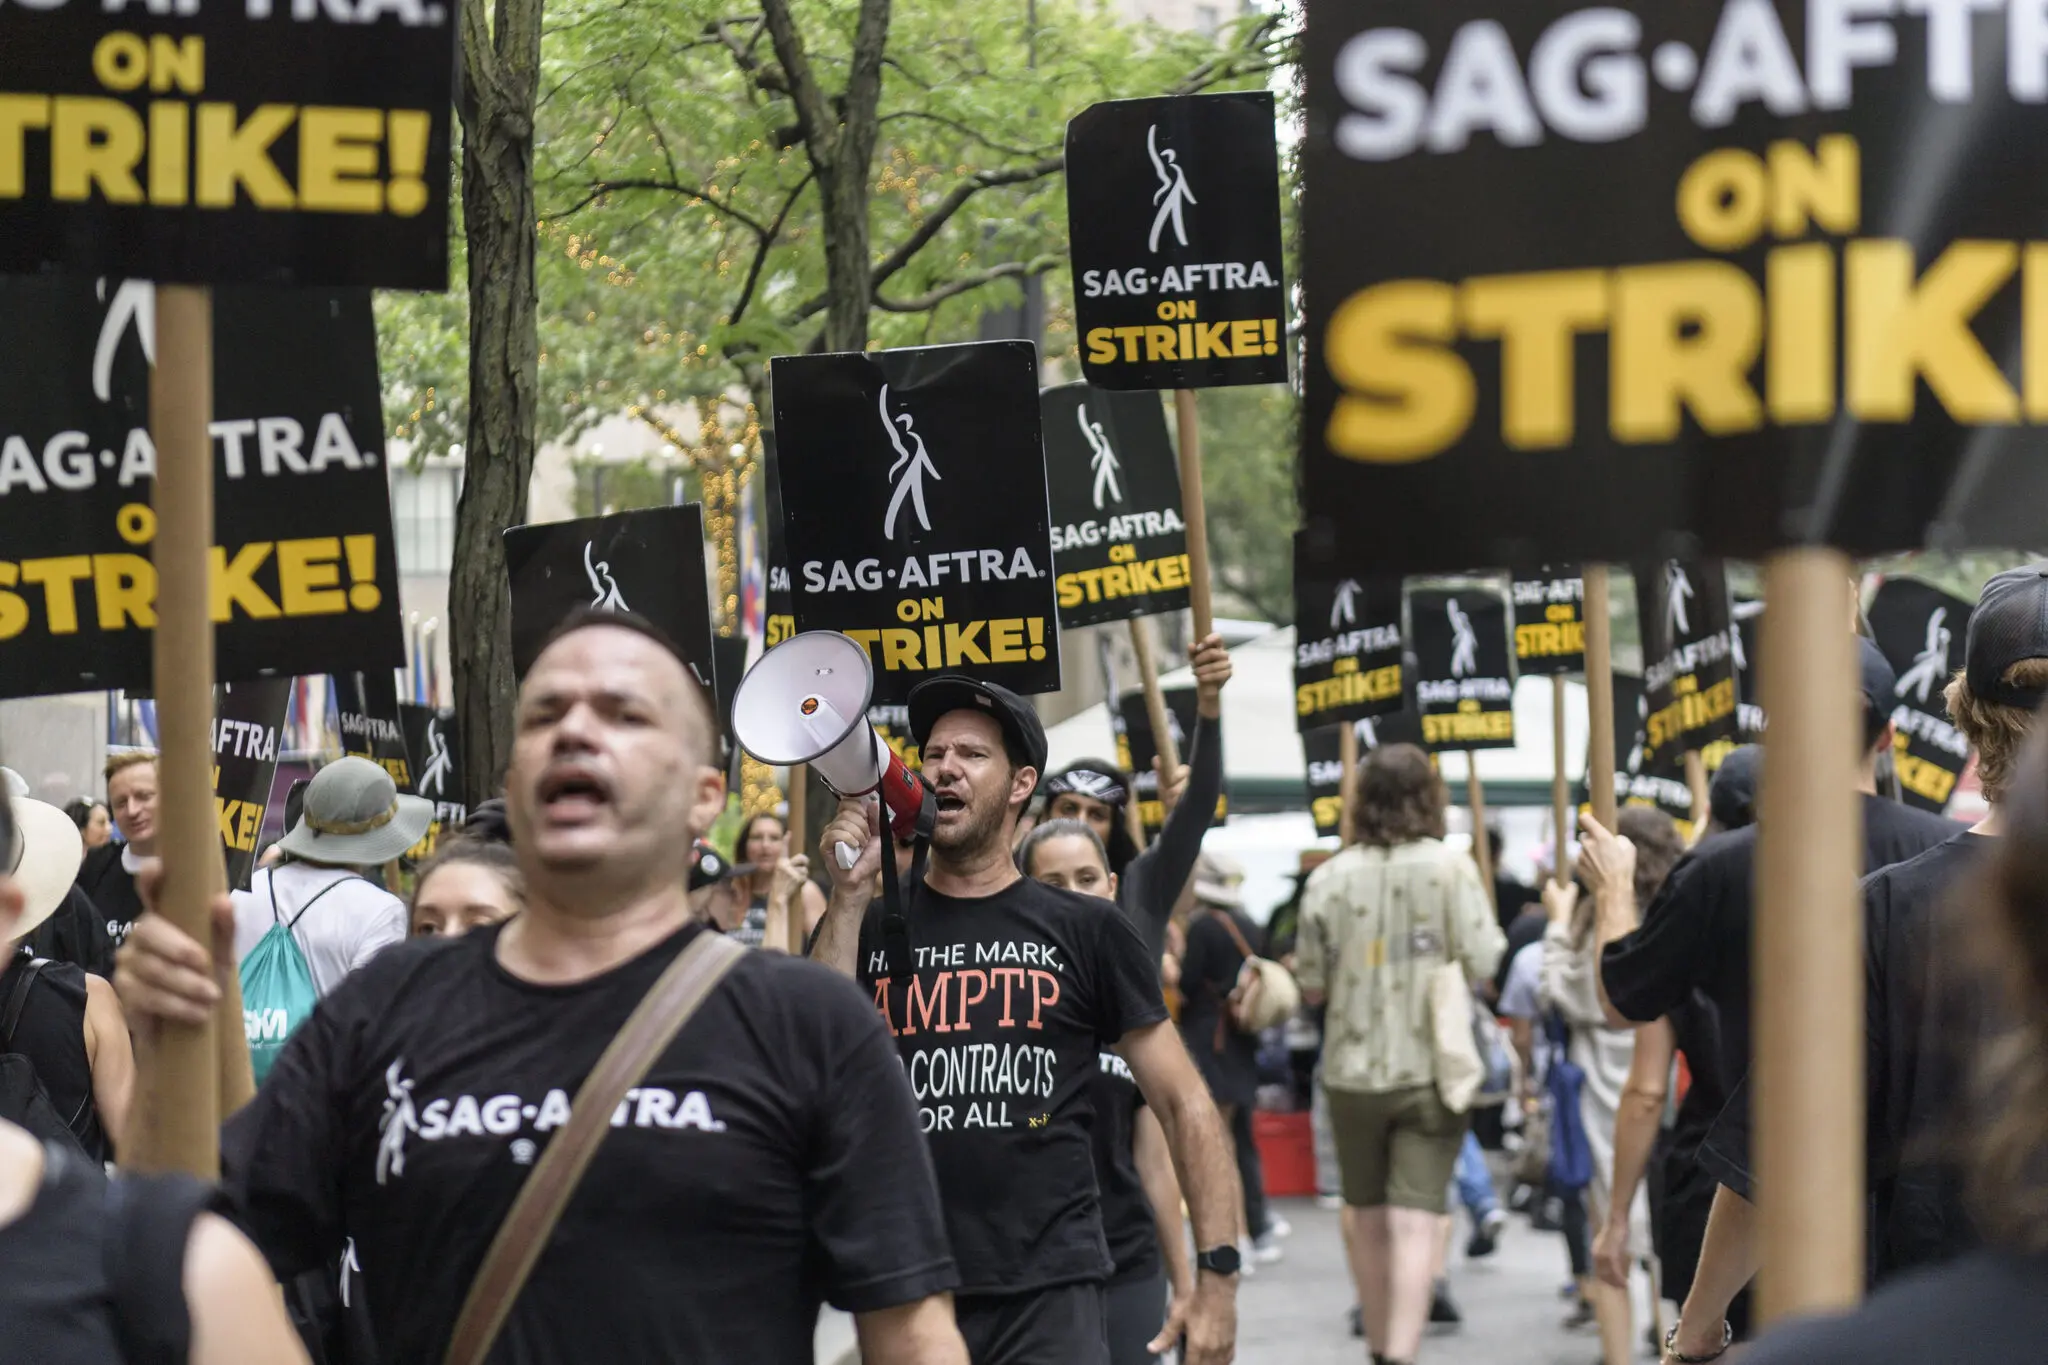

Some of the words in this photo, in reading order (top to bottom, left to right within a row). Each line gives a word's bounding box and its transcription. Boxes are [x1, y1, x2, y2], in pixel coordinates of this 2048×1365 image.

[93, 31, 205, 93] ON
[0, 92, 431, 217] TRIKE!
[1676, 134, 1861, 250] ON
[1157, 300, 1197, 321] ON
[1086, 318, 1279, 365] STRIKE!
[1324, 238, 2048, 464] STRIK
[116, 503, 157, 545] O
[1056, 553, 1191, 608] STRIKE!
[1108, 543, 1136, 564] ON
[0, 534, 382, 640] TRKE!
[896, 596, 944, 622] ON
[842, 617, 1046, 671] TRIKE!
[1515, 621, 1585, 658] STRIK
[914, 944, 966, 968] THE
[975, 941, 1064, 972] MARK,
[874, 968, 1061, 1037] AMPTP
[910, 1043, 1057, 1101] CONTRACTS
[918, 1104, 955, 1134] OR
[963, 1101, 1013, 1128] ALL
